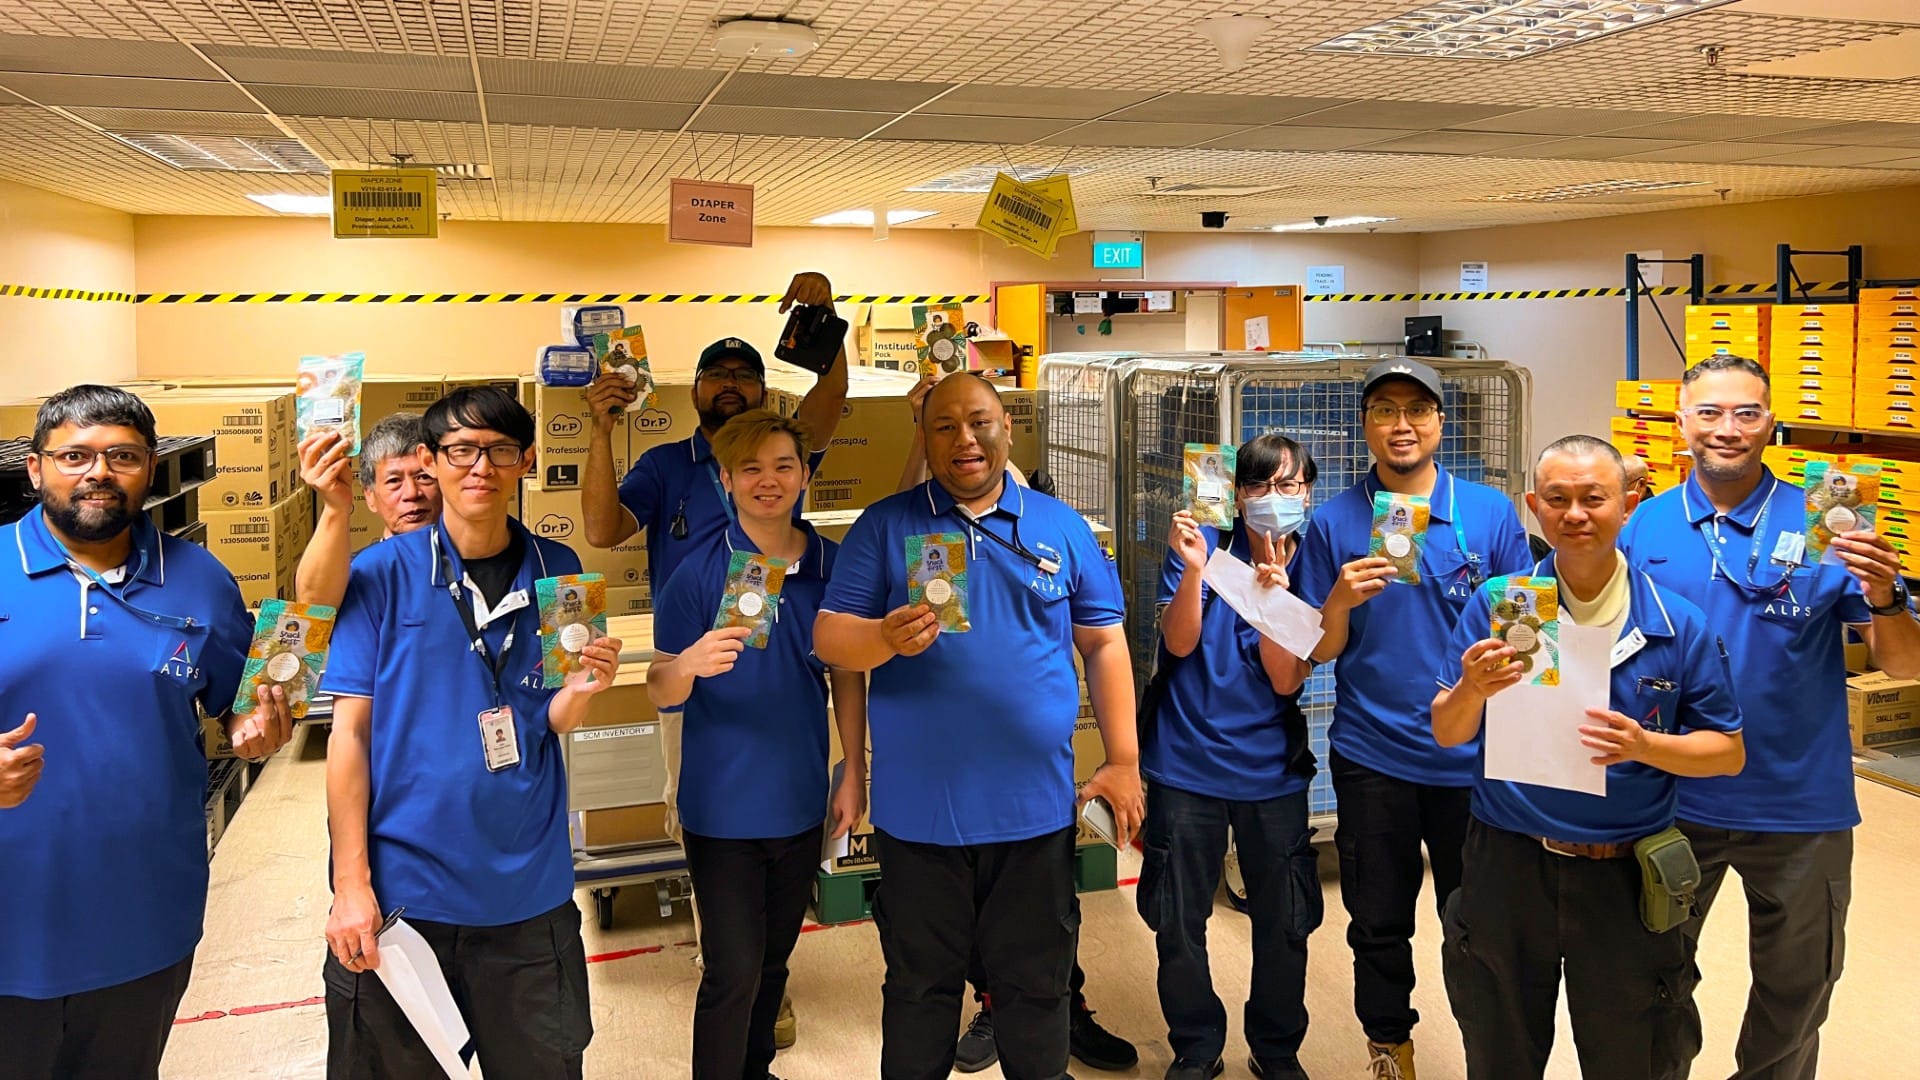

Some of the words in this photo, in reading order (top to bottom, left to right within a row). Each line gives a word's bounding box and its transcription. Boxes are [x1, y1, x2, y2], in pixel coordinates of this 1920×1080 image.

[691, 198, 735, 210] DIAPER
[698, 212, 726, 224] Zone
[1103, 247, 1132, 264] EXIT
[552, 423, 578, 432] Dr.P
[640, 417, 667, 427] Dr.P
[212, 428, 262, 436] 133050068000
[831, 438, 868, 447] Professi
[546, 446, 590, 454] Profession
[216, 465, 263, 474] ofessional
[558, 466, 568, 480] L
[541, 523, 569, 534] Dr.P
[220, 536, 270, 544] 133050068000
[234, 572, 270, 582] essional
[1030, 580, 1062, 596] ALPS
[1448, 586, 1472, 597] AL
[1764, 604, 1812, 617] ALPS
[160, 663, 200, 679] ALPS
[520, 675, 544, 690] AL
[1867, 690, 1900, 705] Vibrant
[583, 732, 600, 740] SCM
[602, 727, 646, 737] INVENTORY
[849, 836, 868, 856] M
